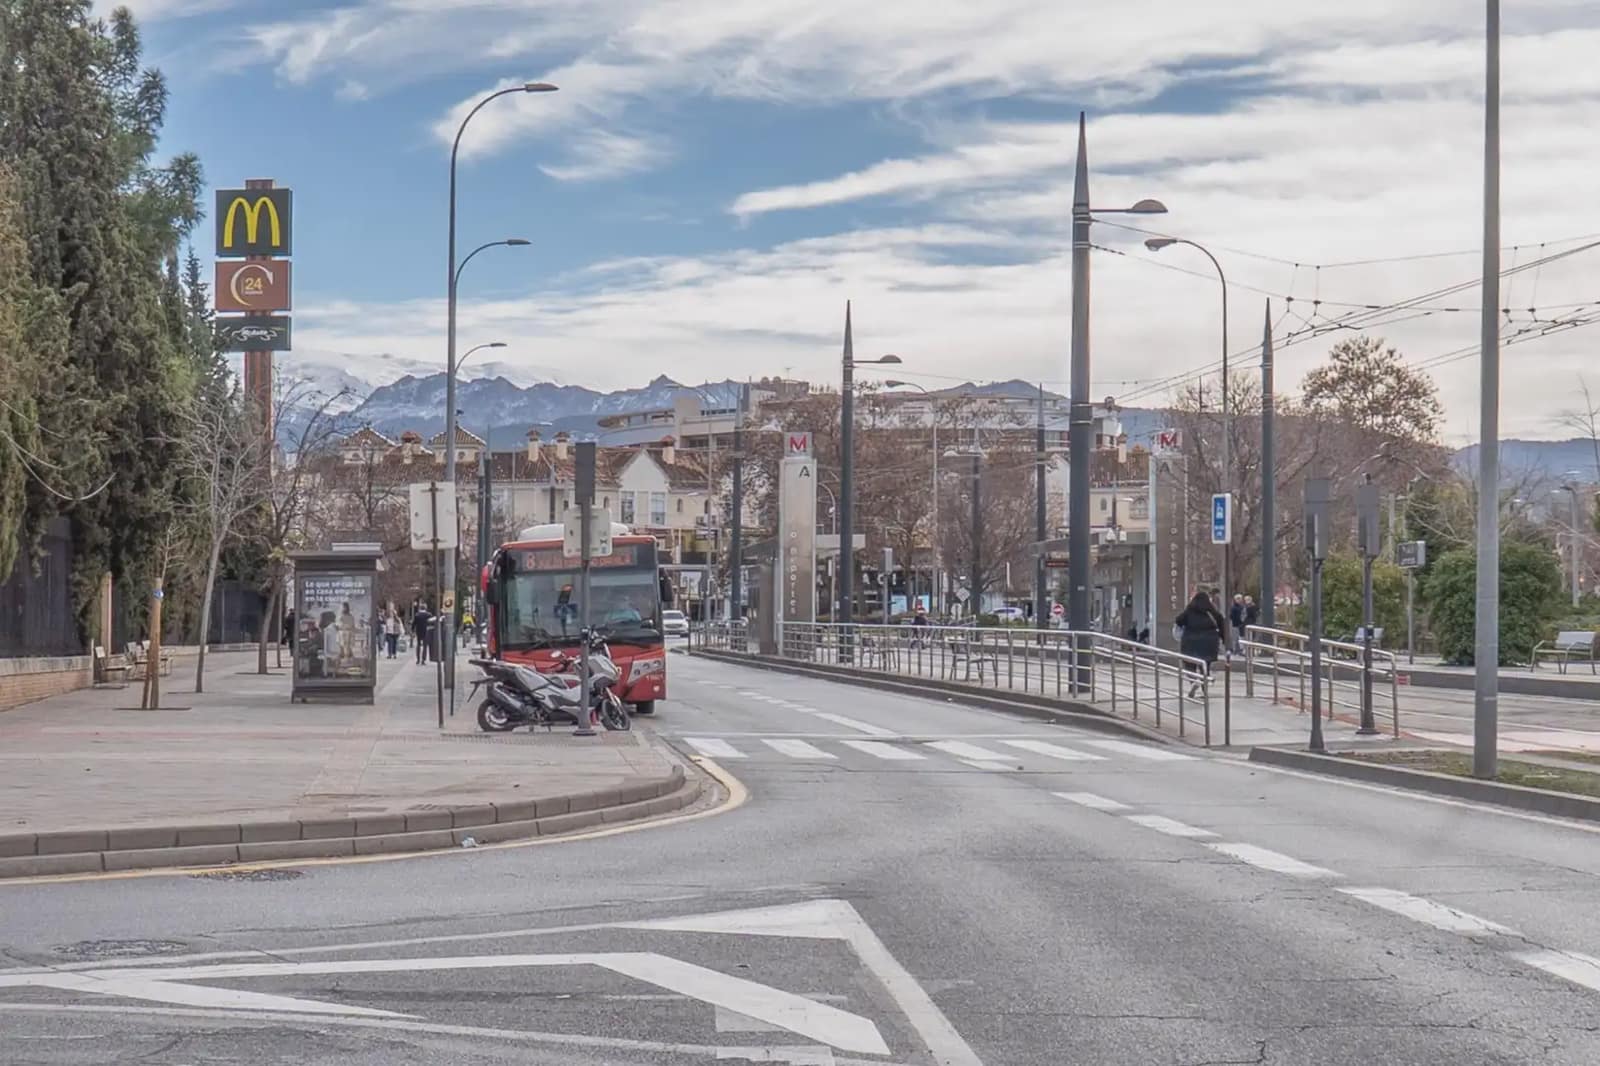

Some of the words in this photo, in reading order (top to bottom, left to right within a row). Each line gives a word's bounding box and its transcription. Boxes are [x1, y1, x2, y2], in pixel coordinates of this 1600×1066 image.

[245, 278, 263, 290] 24
[790, 435, 807, 451] M
[1159, 433, 1178, 448] M
[527, 554, 536, 570] 8
